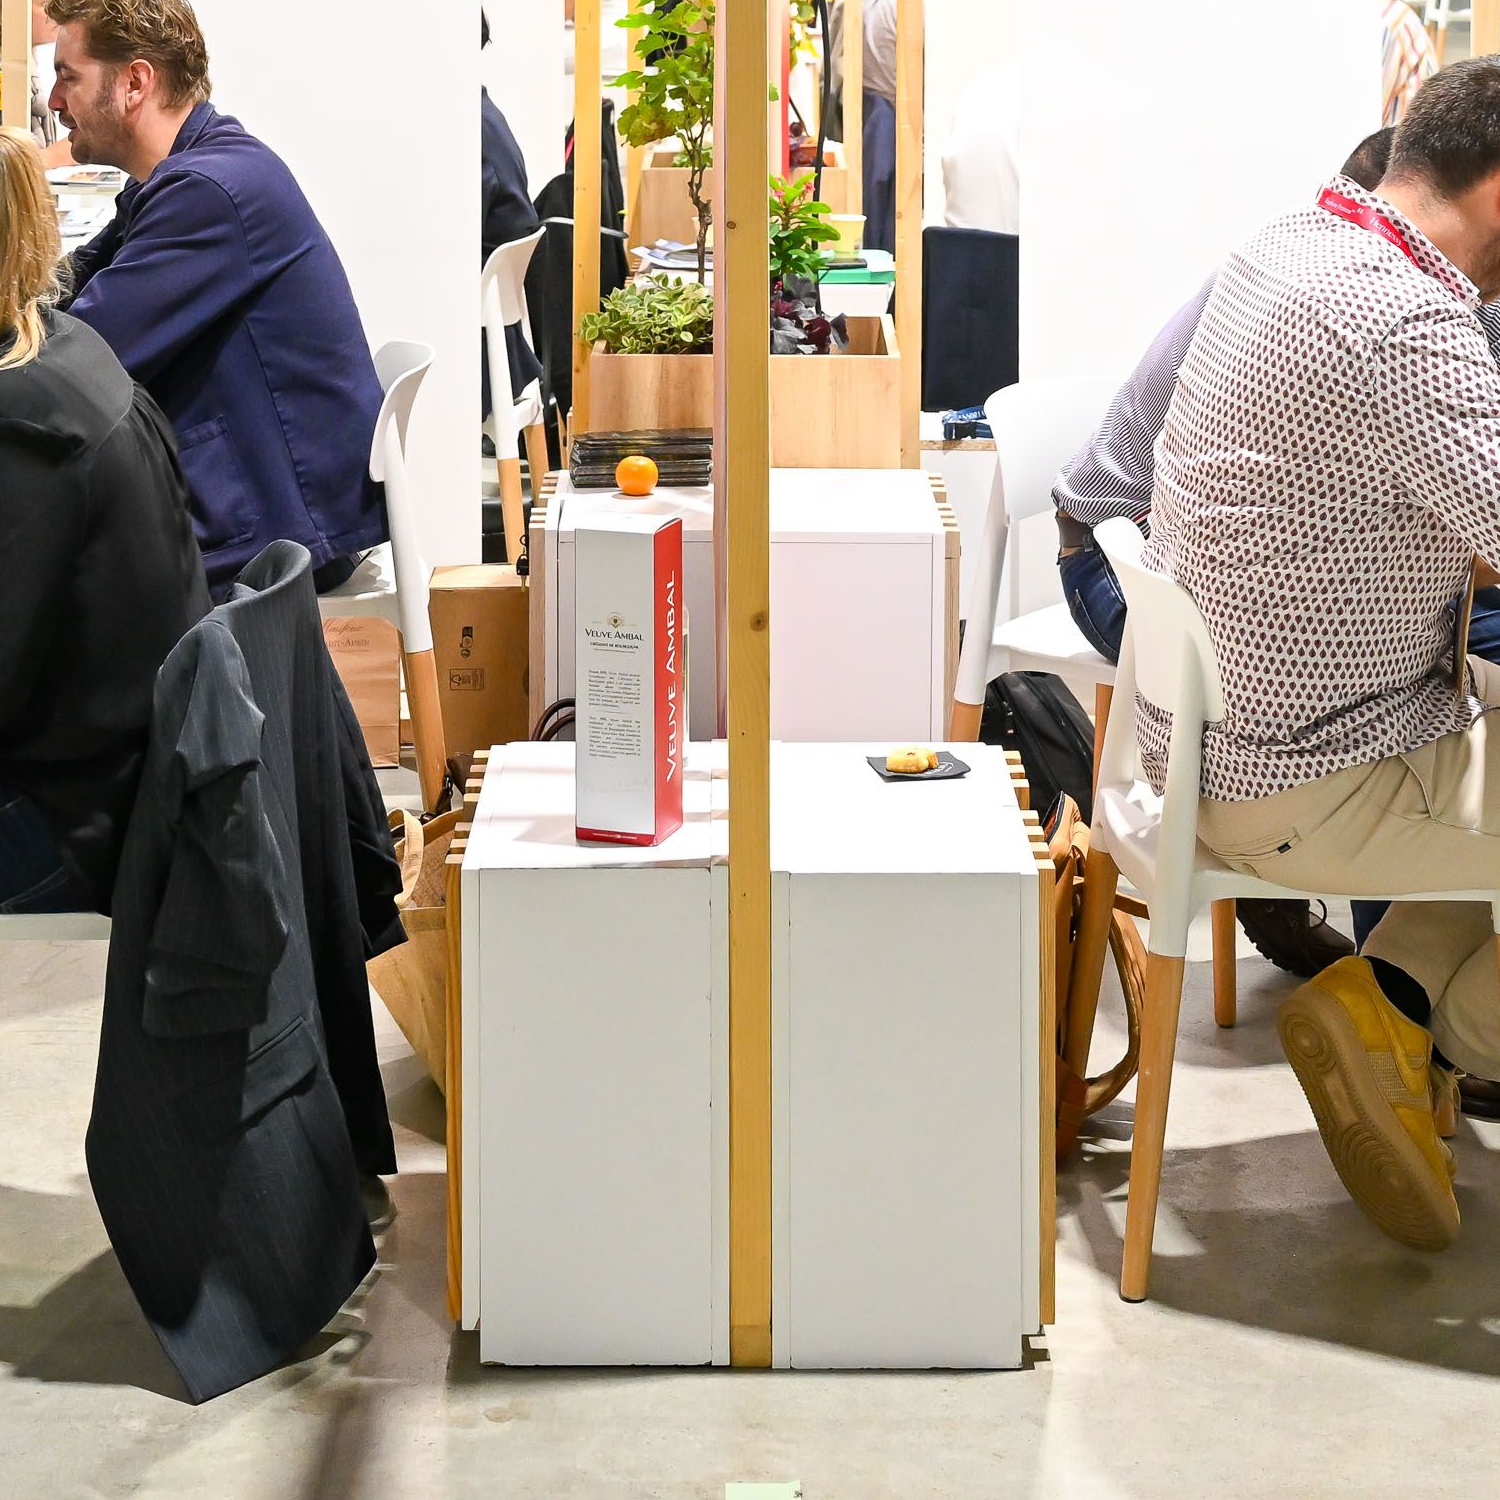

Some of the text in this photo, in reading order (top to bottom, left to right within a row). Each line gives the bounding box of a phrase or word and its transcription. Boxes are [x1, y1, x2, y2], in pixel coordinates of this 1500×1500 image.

[1369, 216, 1402, 246] Hennessy
[665, 570, 678, 783] VEUVE AMBAL
